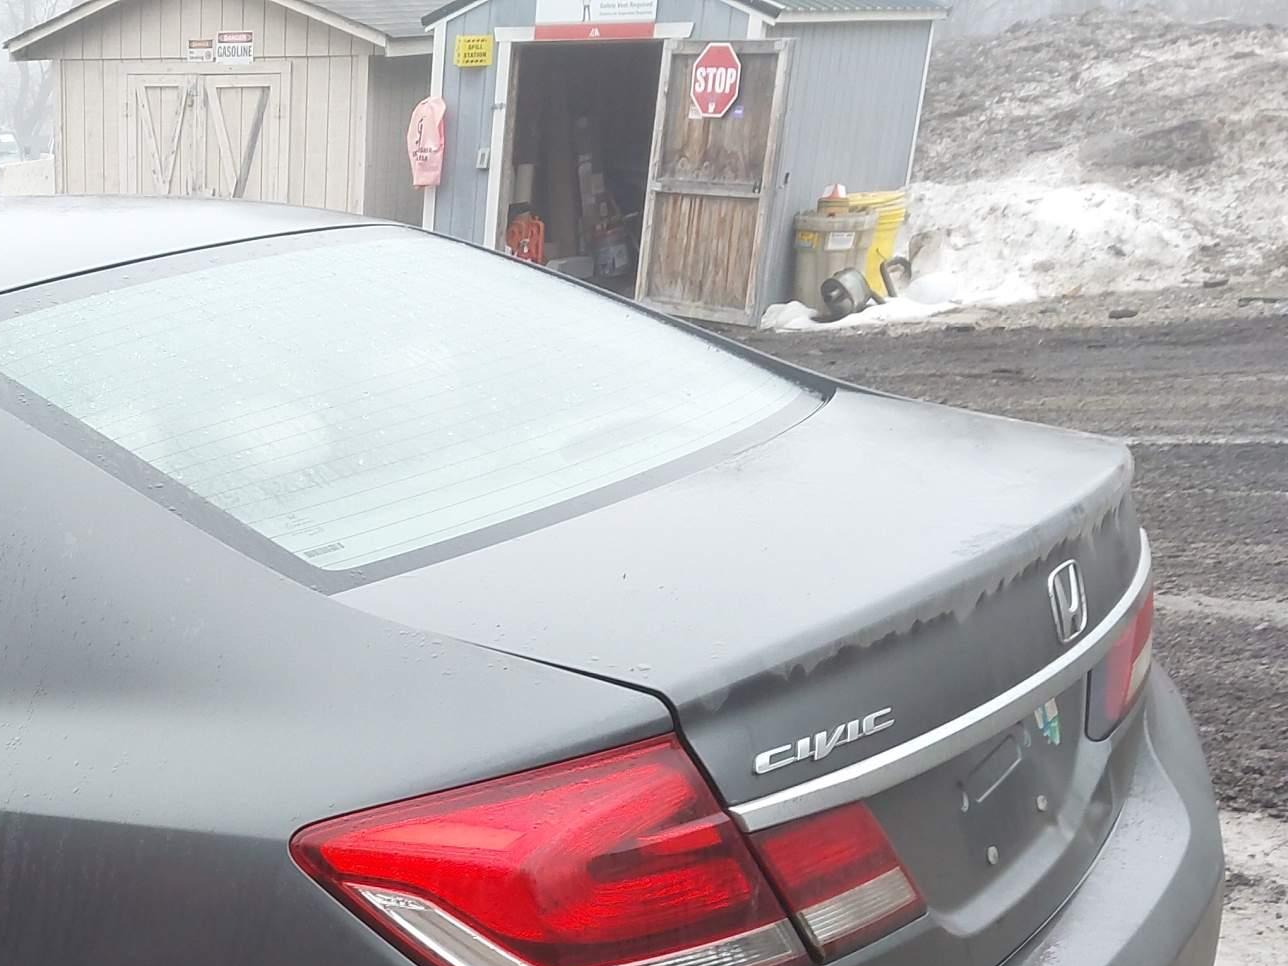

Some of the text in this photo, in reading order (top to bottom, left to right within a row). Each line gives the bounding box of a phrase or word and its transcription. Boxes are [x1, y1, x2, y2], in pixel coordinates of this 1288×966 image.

[217, 45, 252, 58] GASOLINE
[695, 67, 737, 94] STOP
[754, 706, 896, 775] CIVIC
